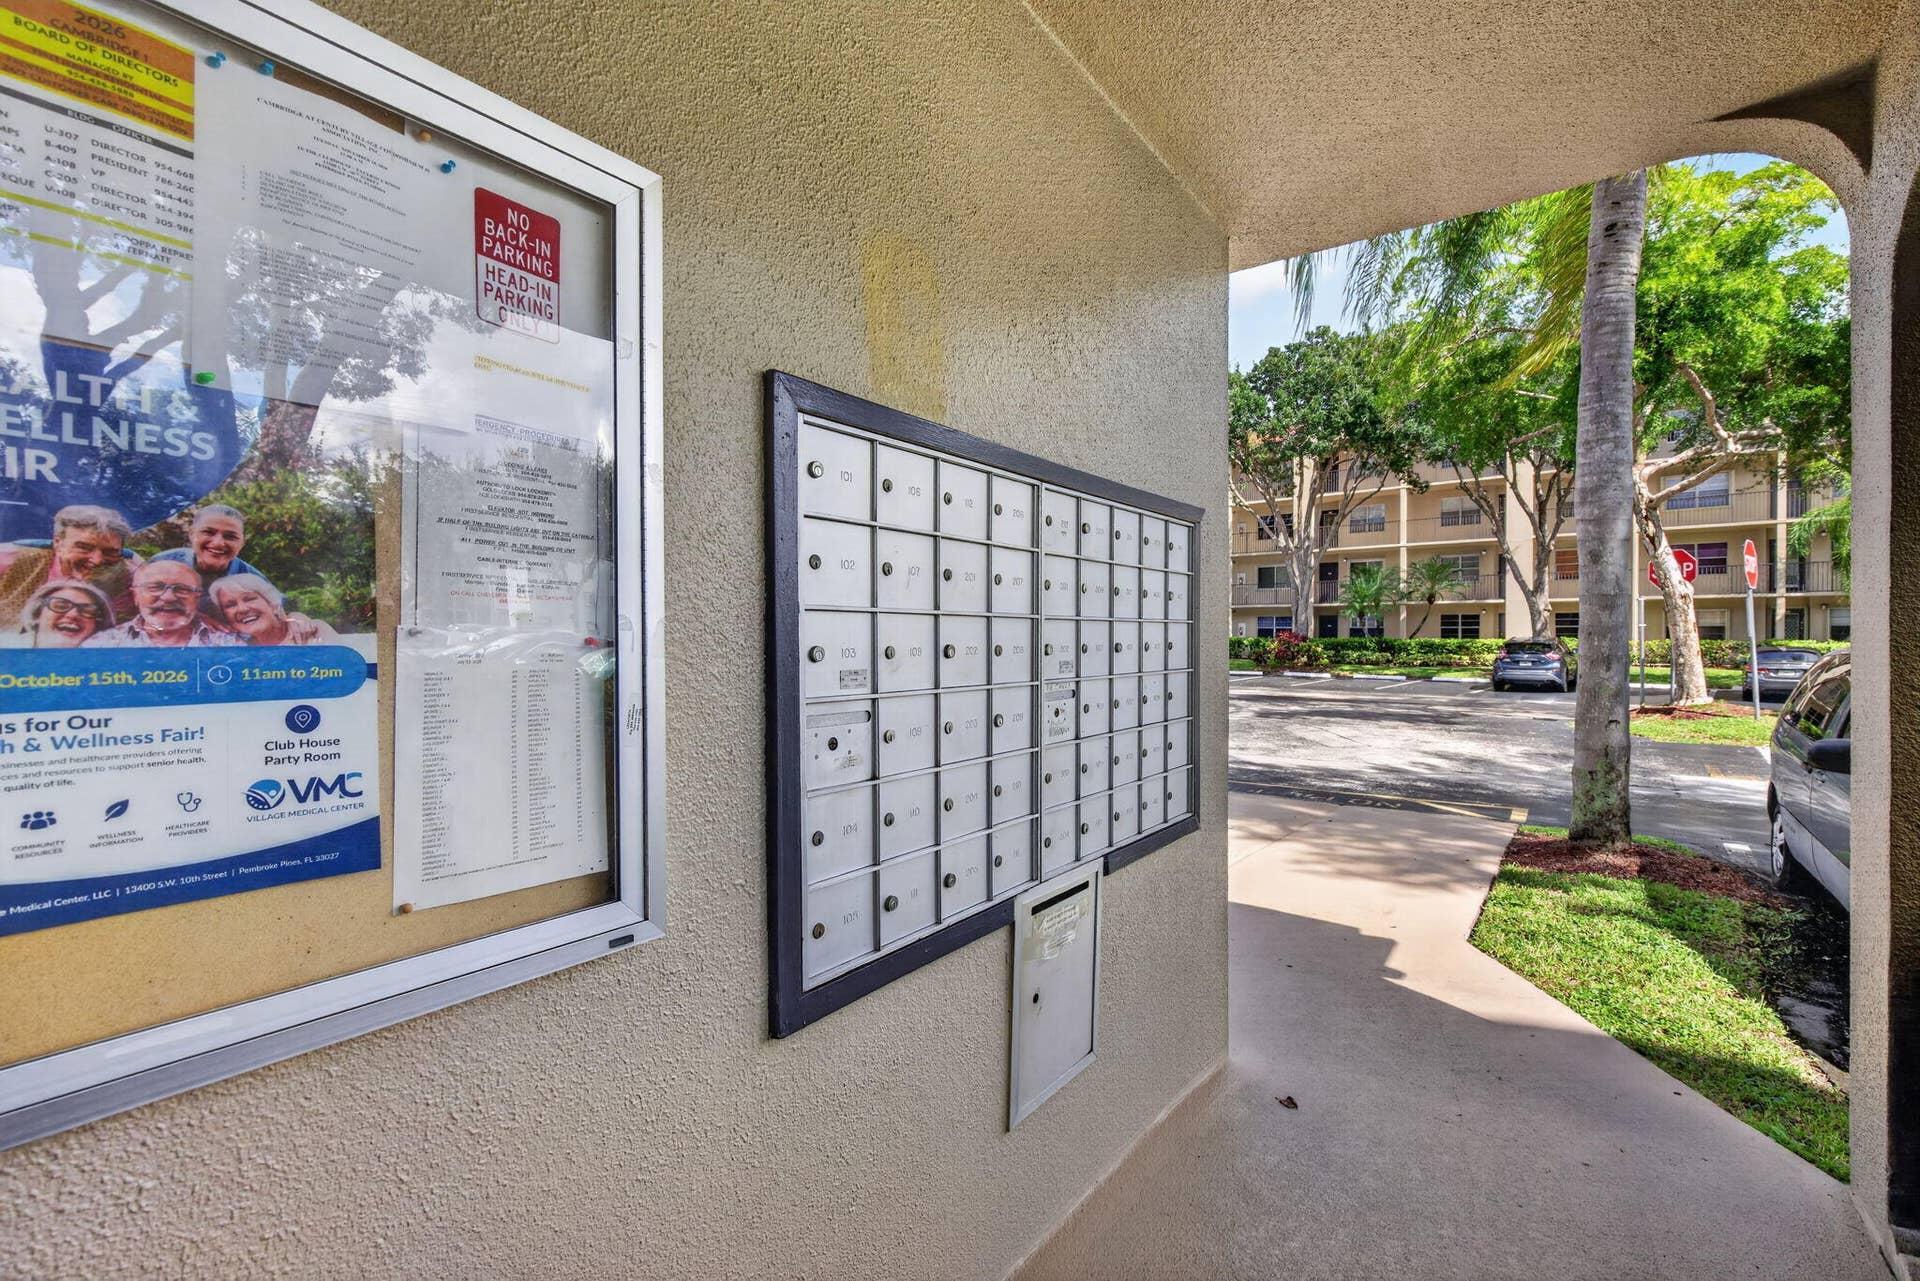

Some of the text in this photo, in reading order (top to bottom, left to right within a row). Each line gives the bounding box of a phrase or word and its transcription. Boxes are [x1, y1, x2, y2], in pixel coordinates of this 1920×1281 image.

[74, 10, 126, 39] 2026
[50, 18, 140, 60] CAMBRIDGE
[13, 15, 70, 44] BOARD
[75, 40, 97, 54] OF
[101, 49, 179, 88] DIRECTORS
[66, 52, 119, 76] MANAGED
[66, 108, 96, 124] BLDG
[45, 125, 79, 141] U-307
[91, 139, 147, 164] DIRECTOR
[91, 153, 149, 177] PRESIDENT
[91, 168, 106, 177] VP
[91, 183, 147, 206] DIRECTOR
[91, 197, 147, 220] DIRECTOR
[507, 208, 530, 231] NO
[485, 218, 551, 258] BACK-IN
[482, 236, 553, 277] PARKING
[485, 263, 551, 300] HEAD-IN
[484, 282, 553, 320] PARKING
[499, 307, 543, 334] ONLY
[166, 391, 200, 423] &
[840, 470, 853, 483] 101
[840, 559, 856, 570] 102
[908, 566, 920, 577] 107
[841, 647, 856, 660] 103
[909, 646, 922, 657] 108
[0, 666, 343, 689] October 15th, 2026 11am to 2pm
[25, 715, 112, 733] for Our
[23, 738, 41, 752] &
[51, 733, 154, 751] Wellness
[161, 727, 205, 742] Fair!
[264, 737, 341, 751] Club House
[22, 770, 42, 779] and
[44, 767, 92, 777] resources
[95, 765, 106, 773] to
[108, 762, 145, 772] support
[146, 759, 174, 768] senior
[48, 757, 66, 766] and
[69, 752, 120, 763] healthcare
[122, 750, 166, 761] providers
[264, 751, 341, 767] Party Room
[3, 782, 40, 793] quality
[43, 780, 54, 788] of
[287, 772, 363, 804] VMC
[246, 801, 366, 823] VILLAGE MEDICAL CENTER
[97, 830, 137, 840] WELLNESS
[165, 820, 209, 831] HEALTHCARE
[168, 827, 208, 838] PROVIDERS
[11, 840, 66, 852] COMMUNITY
[15, 848, 64, 860] RESOURCES
[89, 837, 144, 849] INFORMATION
[10, 901, 51, 915] Medical
[93, 889, 112, 900] LLC
[125, 882, 156, 895] 13400
[180, 874, 201, 885] 10th
[202, 869, 228, 881] Street
[239, 862, 279, 876] Pembroke
[304, 854, 313, 863] FL
